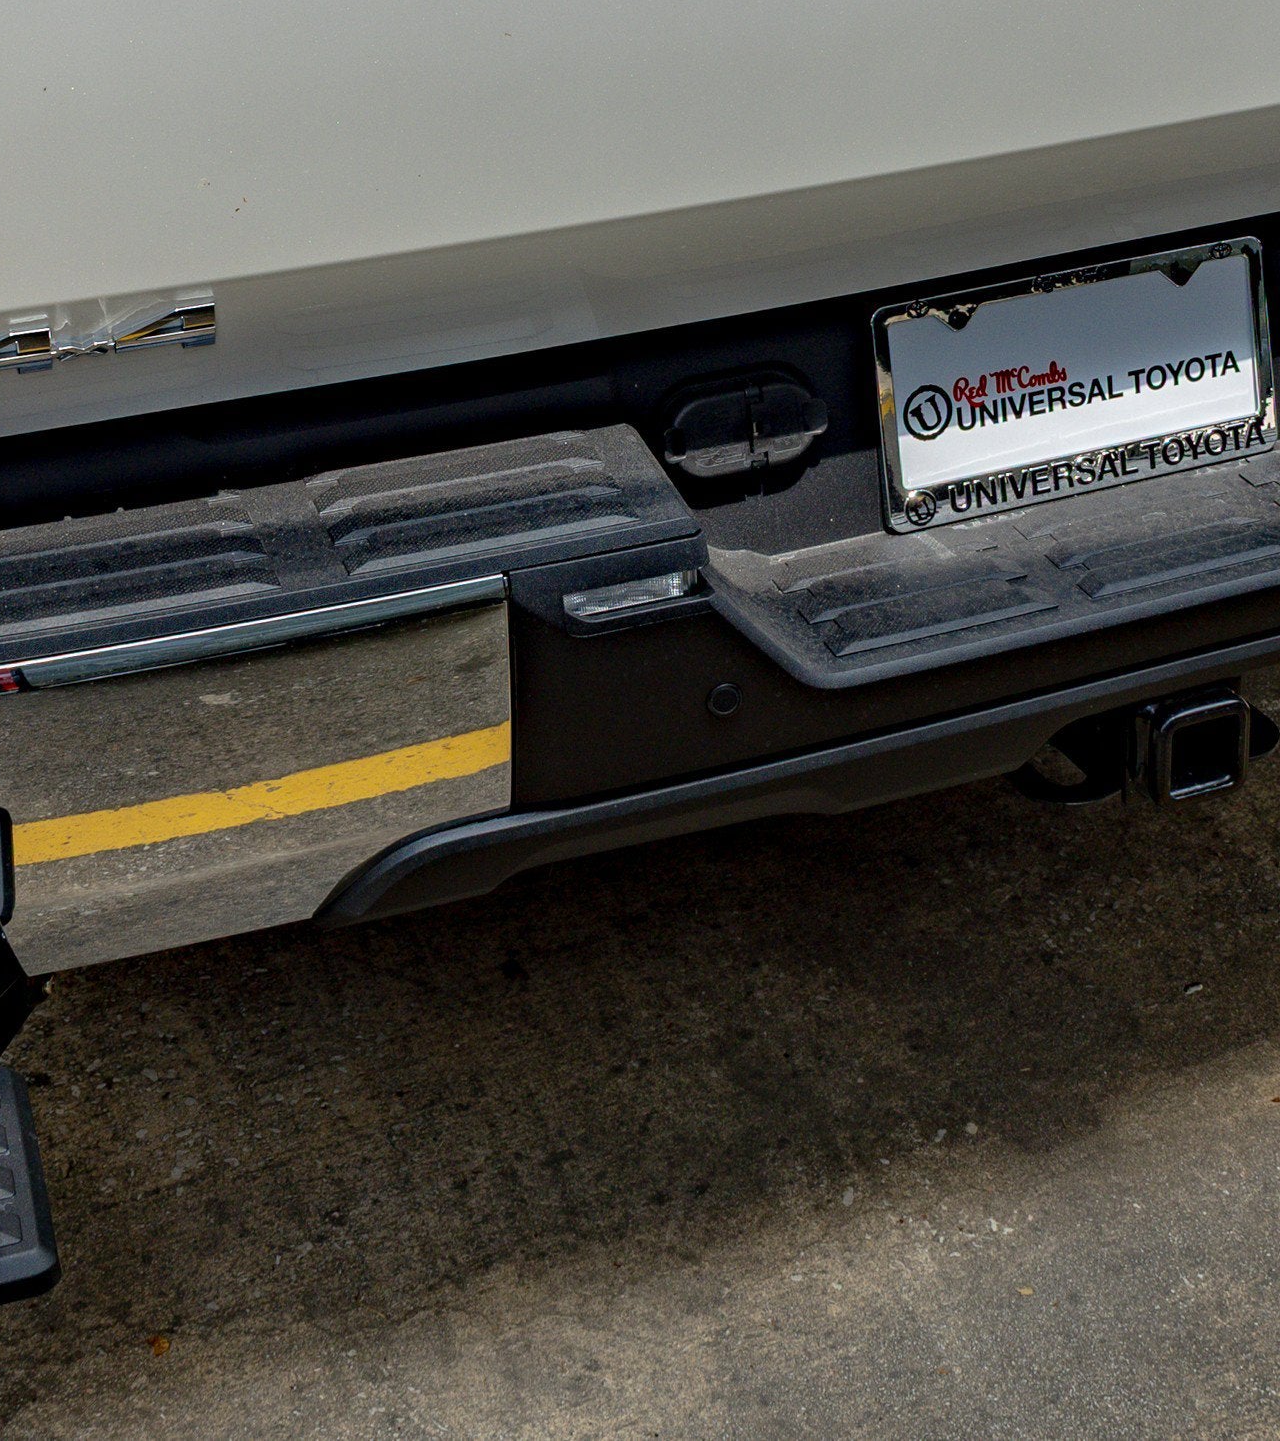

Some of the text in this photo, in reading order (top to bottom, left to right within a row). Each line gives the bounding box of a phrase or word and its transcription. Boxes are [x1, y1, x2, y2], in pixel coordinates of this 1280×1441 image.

[952, 360, 1067, 407] Red McCombs
[956, 350, 1241, 431] UNIVERSAL TOYOTA
[948, 419, 1267, 513] UNIVERSAL TOYOTA
